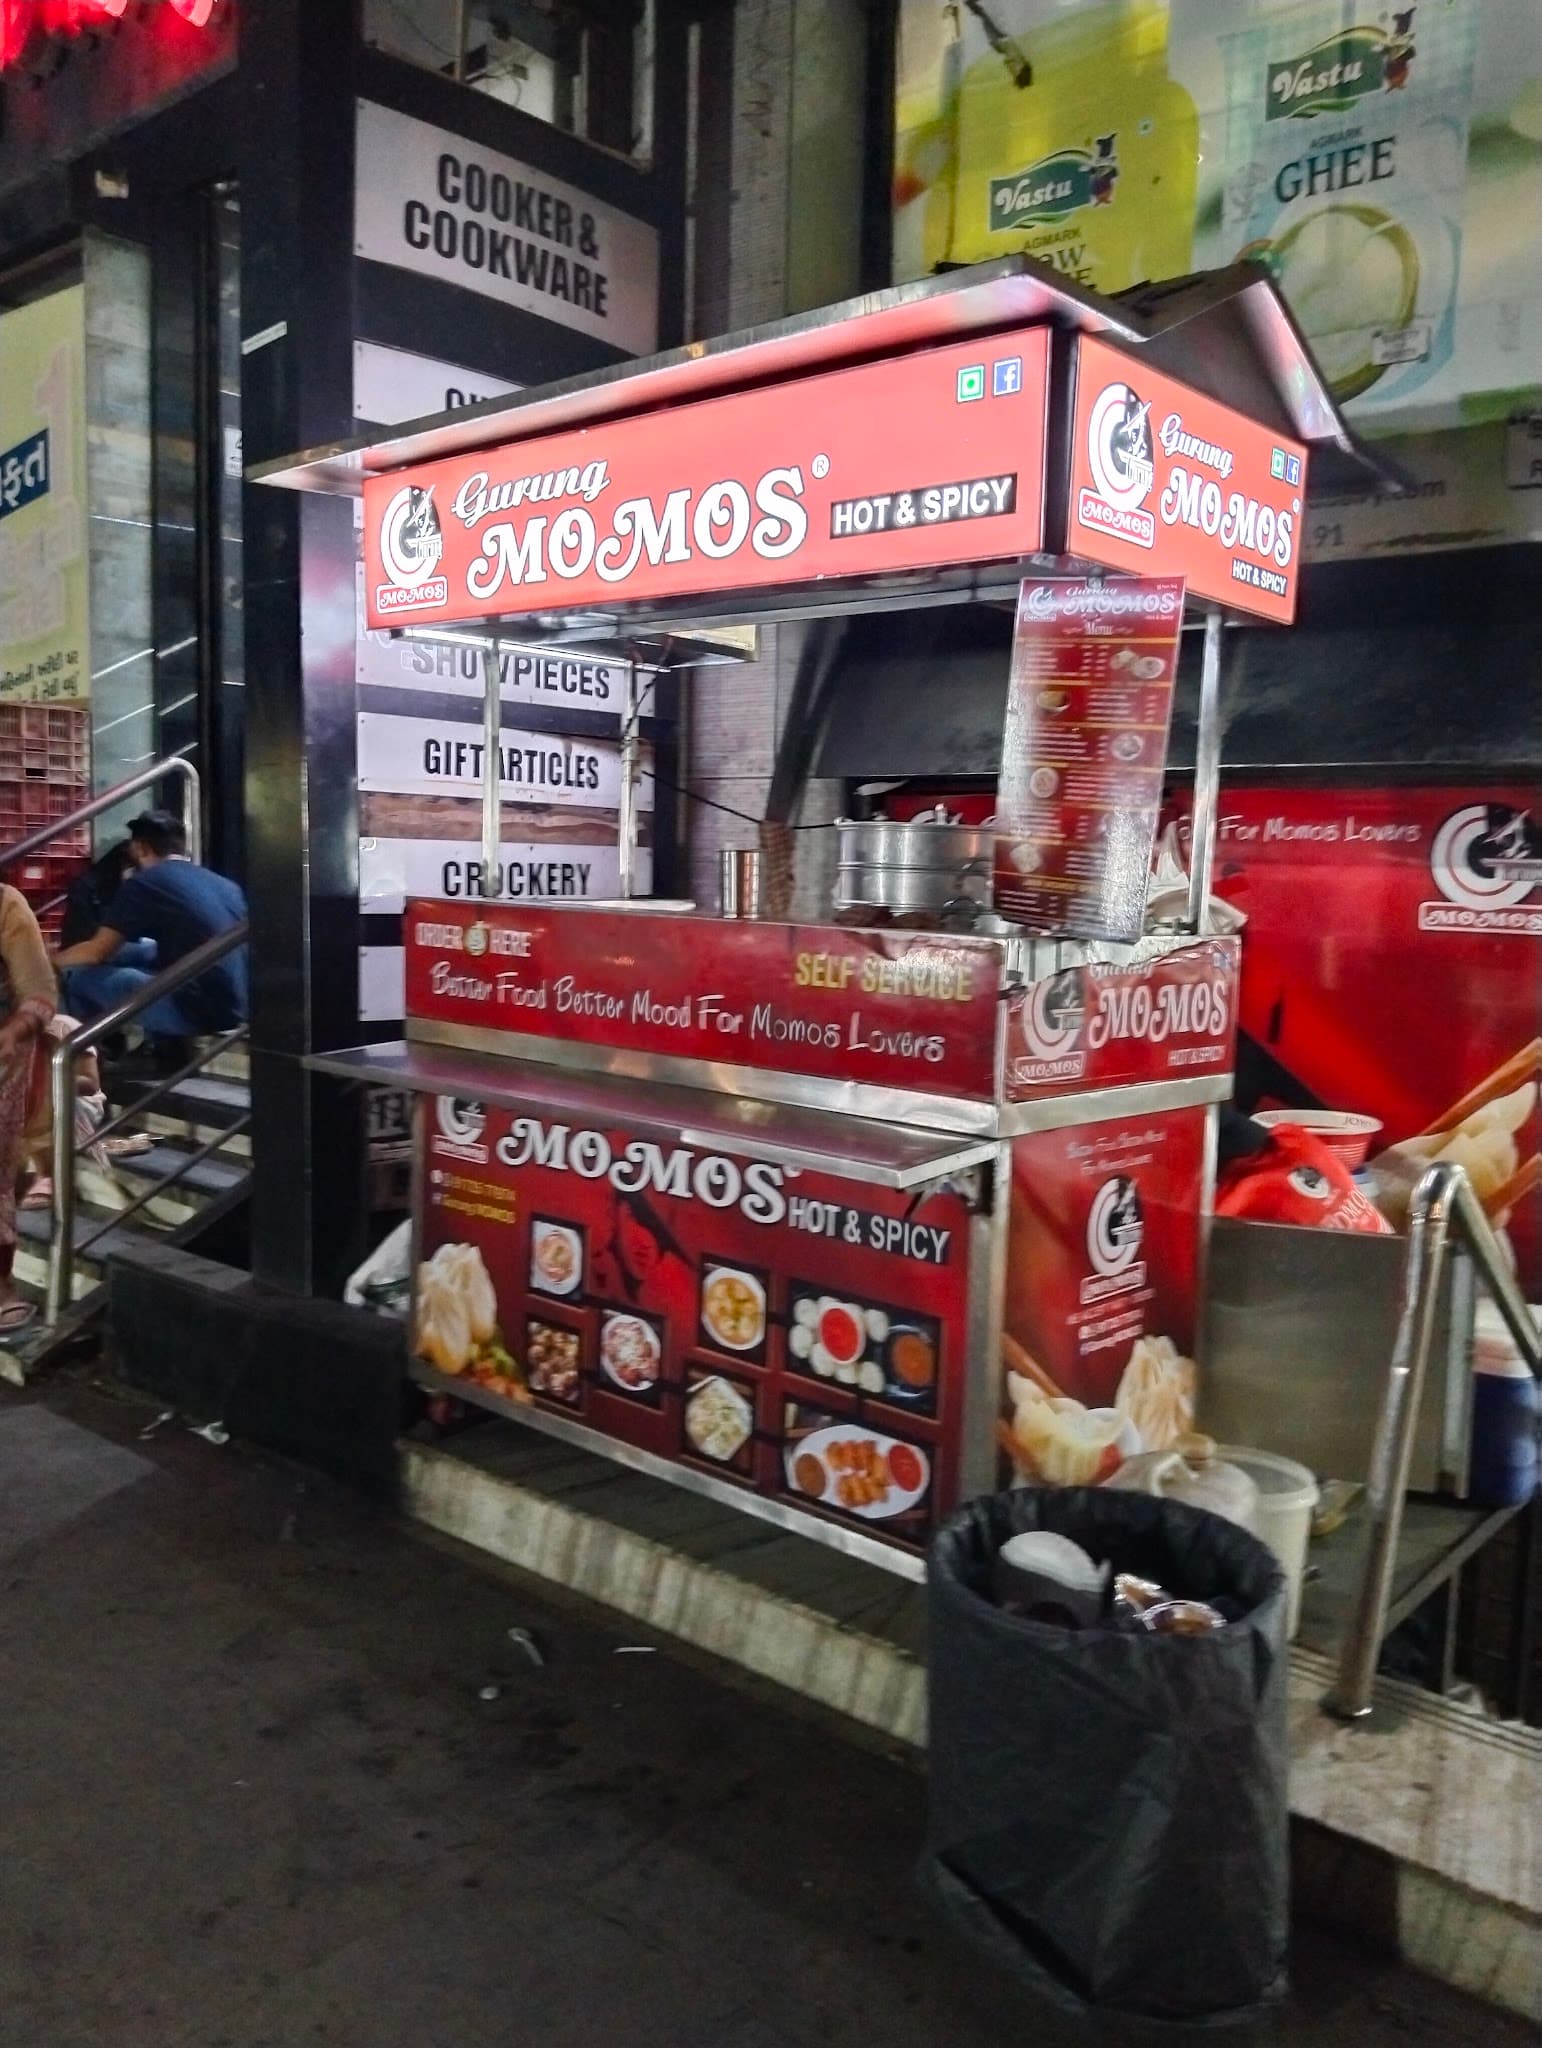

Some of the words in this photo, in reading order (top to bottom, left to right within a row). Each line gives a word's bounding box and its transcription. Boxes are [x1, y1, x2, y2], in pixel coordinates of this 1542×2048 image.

[1272, 60, 1363, 104] Vastu
[1274, 136, 1396, 203] GHEE
[437, 153, 573, 248] COOKER
[578, 213, 598, 260] &
[995, 178, 1073, 216] Vastu
[404, 199, 608, 318] COOKWARE
[1023, 227, 1082, 250] AGMARK
[1158, 413, 1233, 480] Gurung
[451, 461, 611, 529] Gurung
[833, 497, 893, 537] HOT
[898, 495, 916, 526] &
[923, 476, 1013, 522] SPICY
[1082, 501, 1151, 539] MOMOS
[1160, 466, 1293, 568] MOMOS
[466, 465, 808, 600] MOMOS
[379, 582, 444, 608] MOMOS
[1231, 559, 1252, 583] HOT
[1252, 567, 1261, 586] &
[1260, 570, 1287, 596] SPICY
[424, 738, 485, 778] GIFT
[1219, 815, 1260, 842] For
[1262, 816, 1339, 843] Momos
[1344, 816, 1423, 843] Lovers
[442, 861, 592, 897] CRCKERY
[414, 921, 464, 950] ORDER
[488, 928, 533, 958] HERE
[1424, 909, 1542, 931] MOMOS
[795, 952, 854, 990] SELF
[861, 954, 973, 1002] SERVICE
[496, 971, 547, 1009] Food
[552, 974, 625, 1019] Better
[631, 990, 692, 1030] Mood
[696, 993, 744, 1034] For
[749, 1003, 841, 1048] Momos
[847, 1011, 946, 1063] Lovers
[1088, 979, 1227, 1049] MOMOS
[1020, 1058, 1082, 1079] MOMOS
[496, 1118, 786, 1224] MOMOS
[788, 1195, 841, 1237] HOT
[842, 1209, 862, 1244] &
[869, 1214, 951, 1264] SPICY
